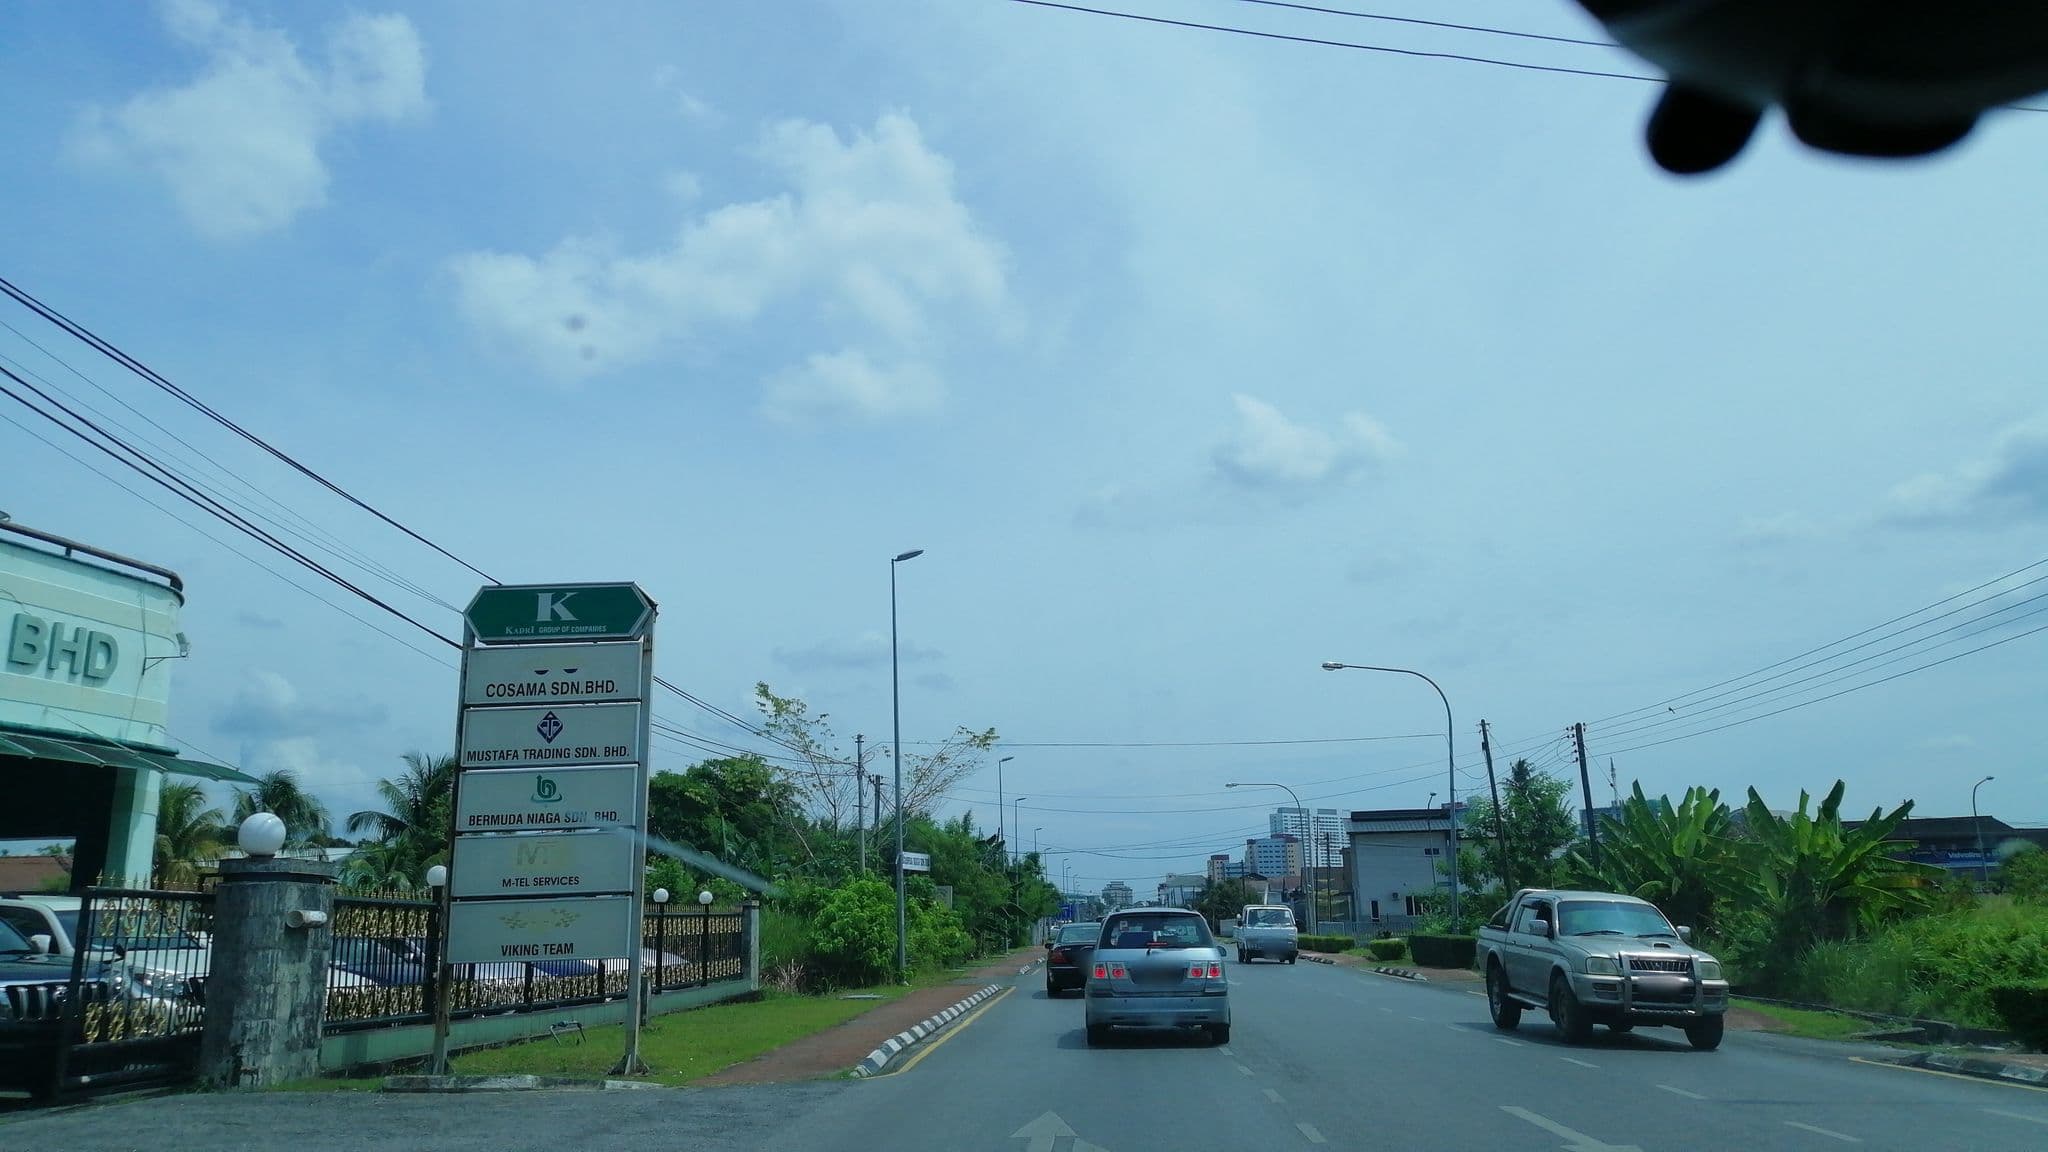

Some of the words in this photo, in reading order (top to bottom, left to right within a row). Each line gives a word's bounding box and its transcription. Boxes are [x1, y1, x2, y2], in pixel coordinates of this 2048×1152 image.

[536, 592, 579, 621] K
[538, 625, 561, 634] GROUP
[561, 625, 570, 633] OF
[8, 613, 118, 680] BHD
[486, 682, 547, 697] COSAMA
[467, 749, 519, 761] MUSTAFA
[522, 747, 571, 760] TRADING
[574, 746, 600, 758] SDN.
[604, 745, 630, 757] BHD.
[468, 813, 523, 826] BERMUDA
[527, 812, 561, 824] NIAGA
[595, 811, 620, 822] BHD.
[502, 877, 530, 888] M-TEL
[533, 876, 580, 887] SERVICES
[501, 944, 539, 957] VIKING
[543, 942, 574, 955] TEAM
